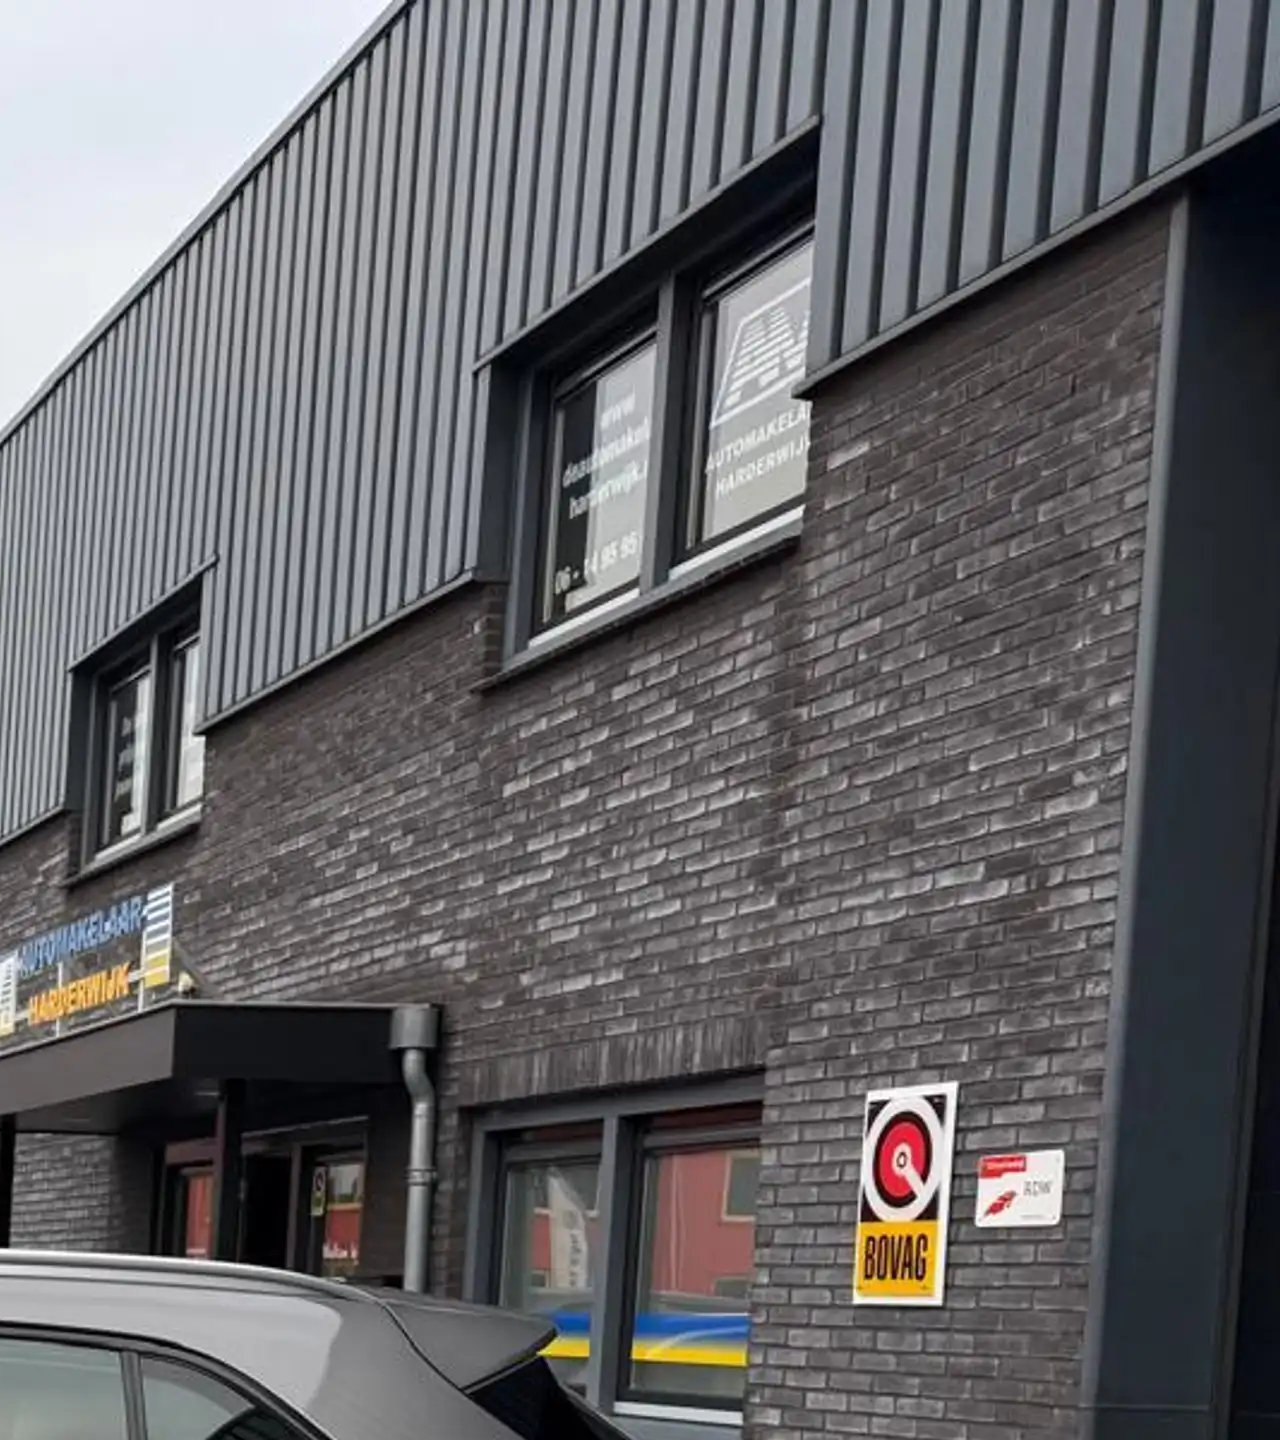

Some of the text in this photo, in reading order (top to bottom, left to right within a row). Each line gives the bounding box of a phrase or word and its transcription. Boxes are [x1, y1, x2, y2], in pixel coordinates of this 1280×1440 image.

[18, 895, 144, 979] AUTOMAKELAAR
[28, 960, 132, 1027] HARDERWIJK
[864, 1234, 928, 1281] BOVAG
